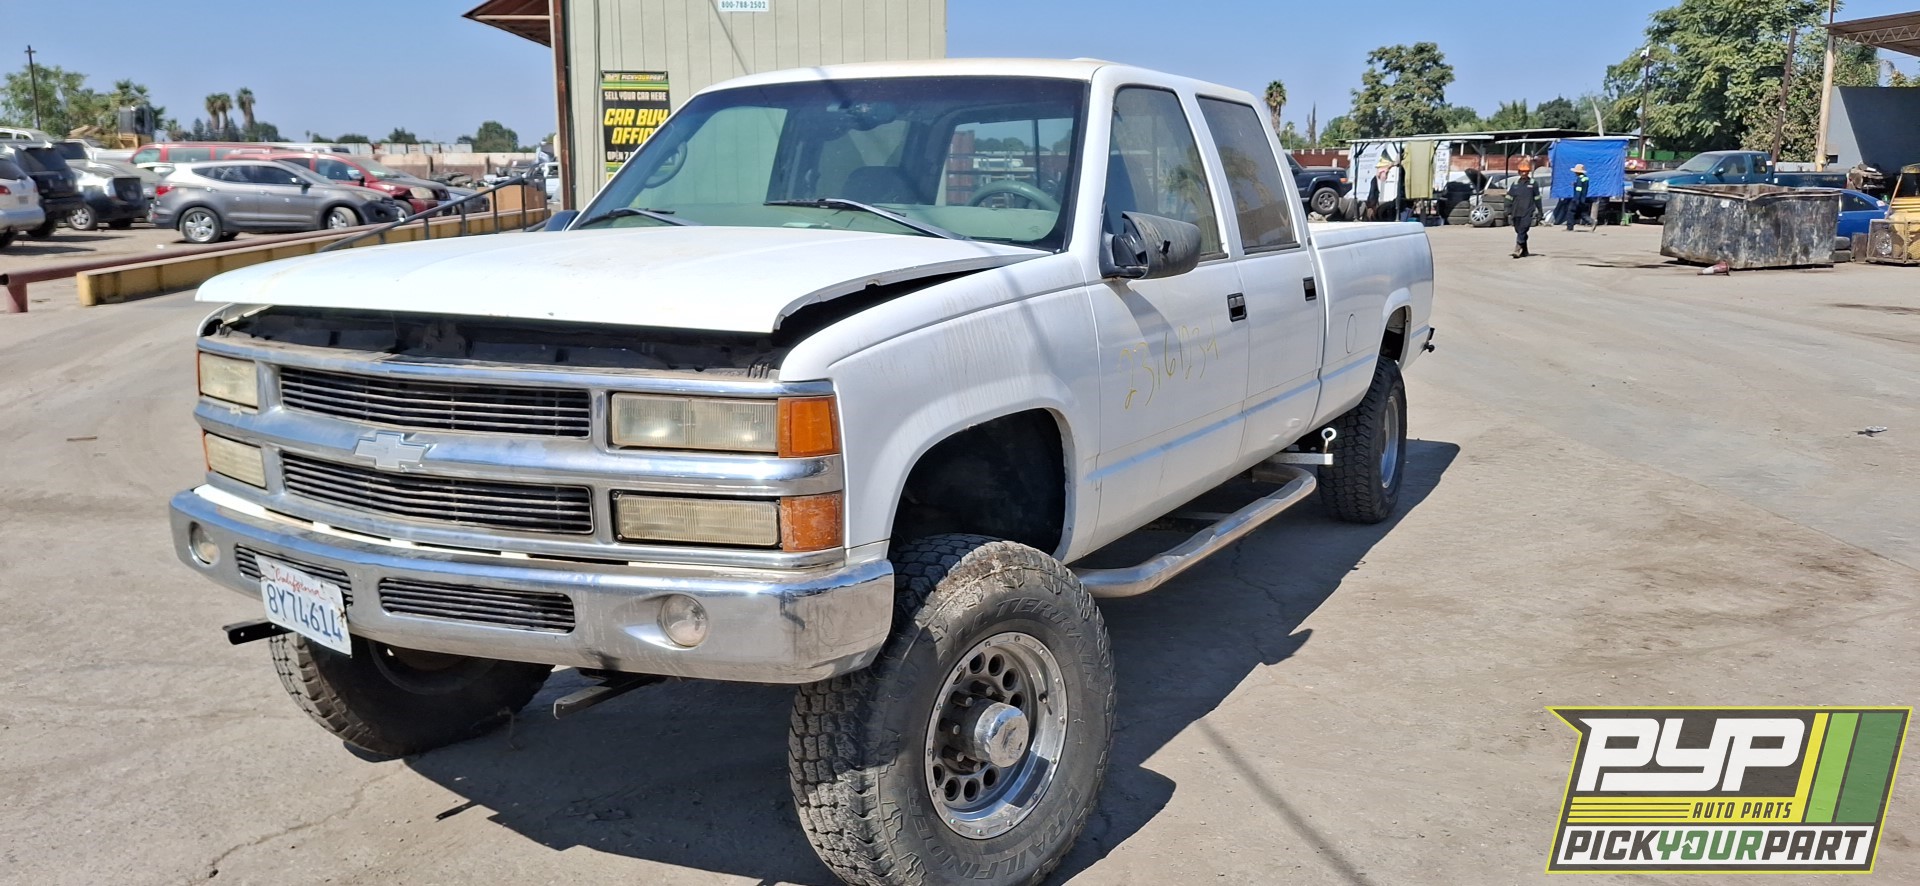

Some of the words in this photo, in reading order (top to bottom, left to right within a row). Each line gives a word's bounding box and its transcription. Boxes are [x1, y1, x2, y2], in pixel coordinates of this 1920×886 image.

[721, 0, 766, 9] 800-788-2502
[604, 91, 619, 101] SELL
[619, 91, 636, 101] YOUR
[637, 91, 650, 101] CAR
[650, 91, 667, 101] HERE
[603, 108, 636, 126] CAR
[636, 108, 669, 126] BUY
[611, 127, 656, 145] OFFIC
[607, 151, 623, 161] OPEN
[274, 567, 326, 600] California
[266, 583, 343, 641] 8Y74614
